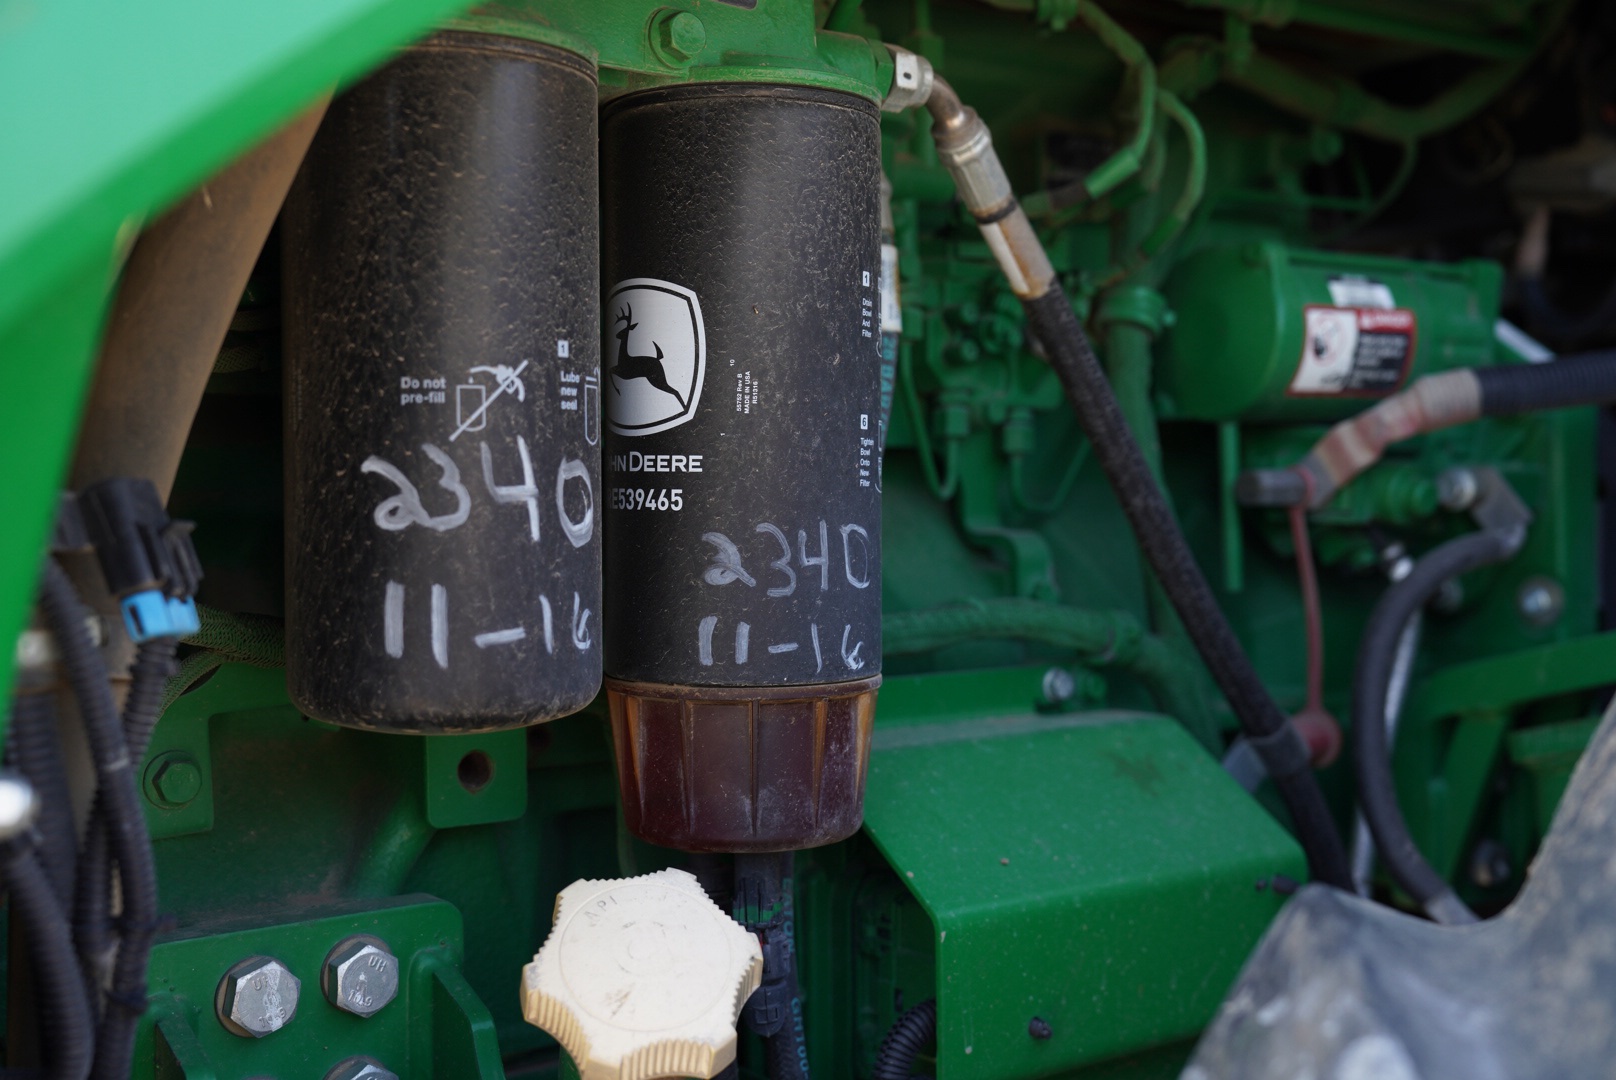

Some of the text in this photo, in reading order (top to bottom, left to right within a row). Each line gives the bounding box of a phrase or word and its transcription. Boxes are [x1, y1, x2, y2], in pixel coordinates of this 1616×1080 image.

[400, 377, 446, 389] Do not
[560, 370, 580, 383] Lube
[560, 387, 578, 396] new
[400, 392, 446, 406] pre-fill
[561, 400, 578, 410] seal
[610, 451, 703, 472] HN DEERE
[360, 434, 594, 548] 2340
[702, 520, 870, 597] 2340
